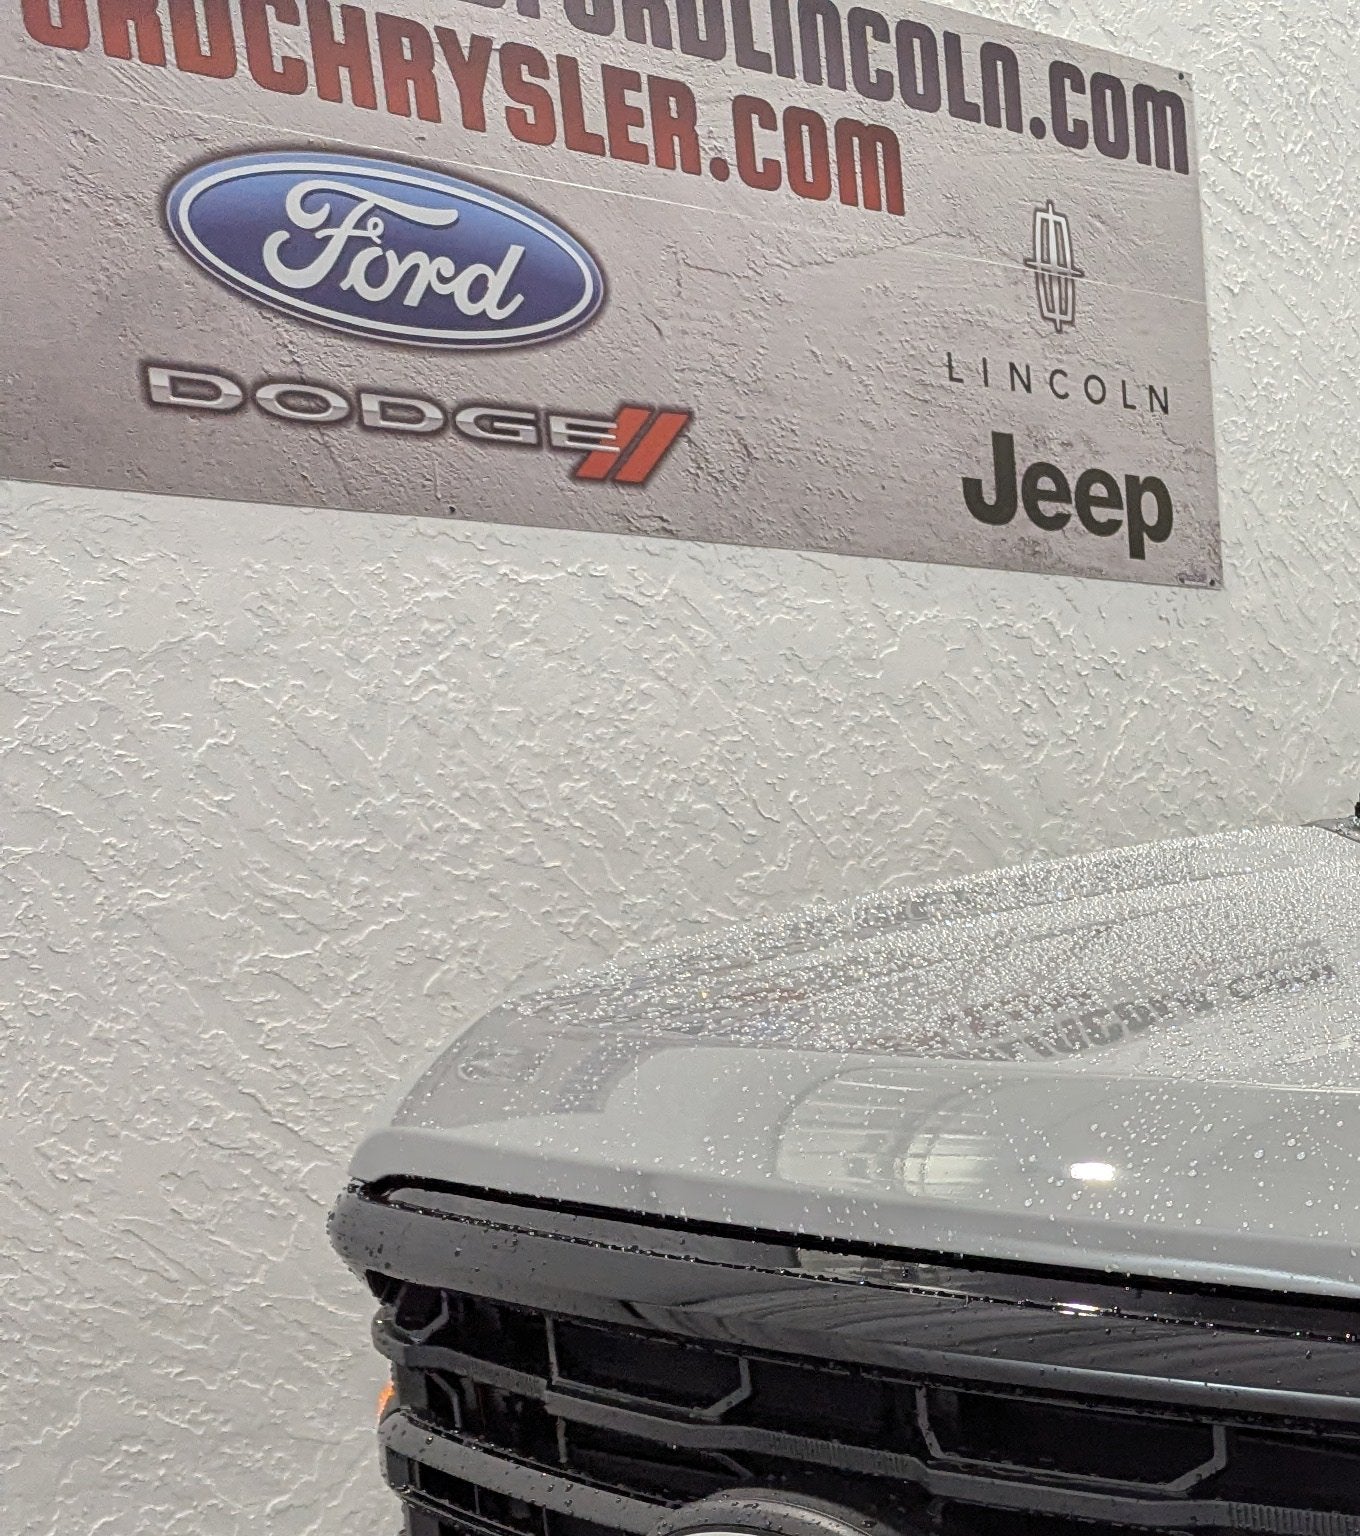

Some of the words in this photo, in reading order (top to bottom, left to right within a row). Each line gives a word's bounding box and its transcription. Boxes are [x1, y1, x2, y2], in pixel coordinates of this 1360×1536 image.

[262, 178, 526, 321] Ford
[146, 366, 621, 453] DODGE
[946, 351, 1170, 415] LINCOLN
[961, 430, 1174, 560] Jeep
